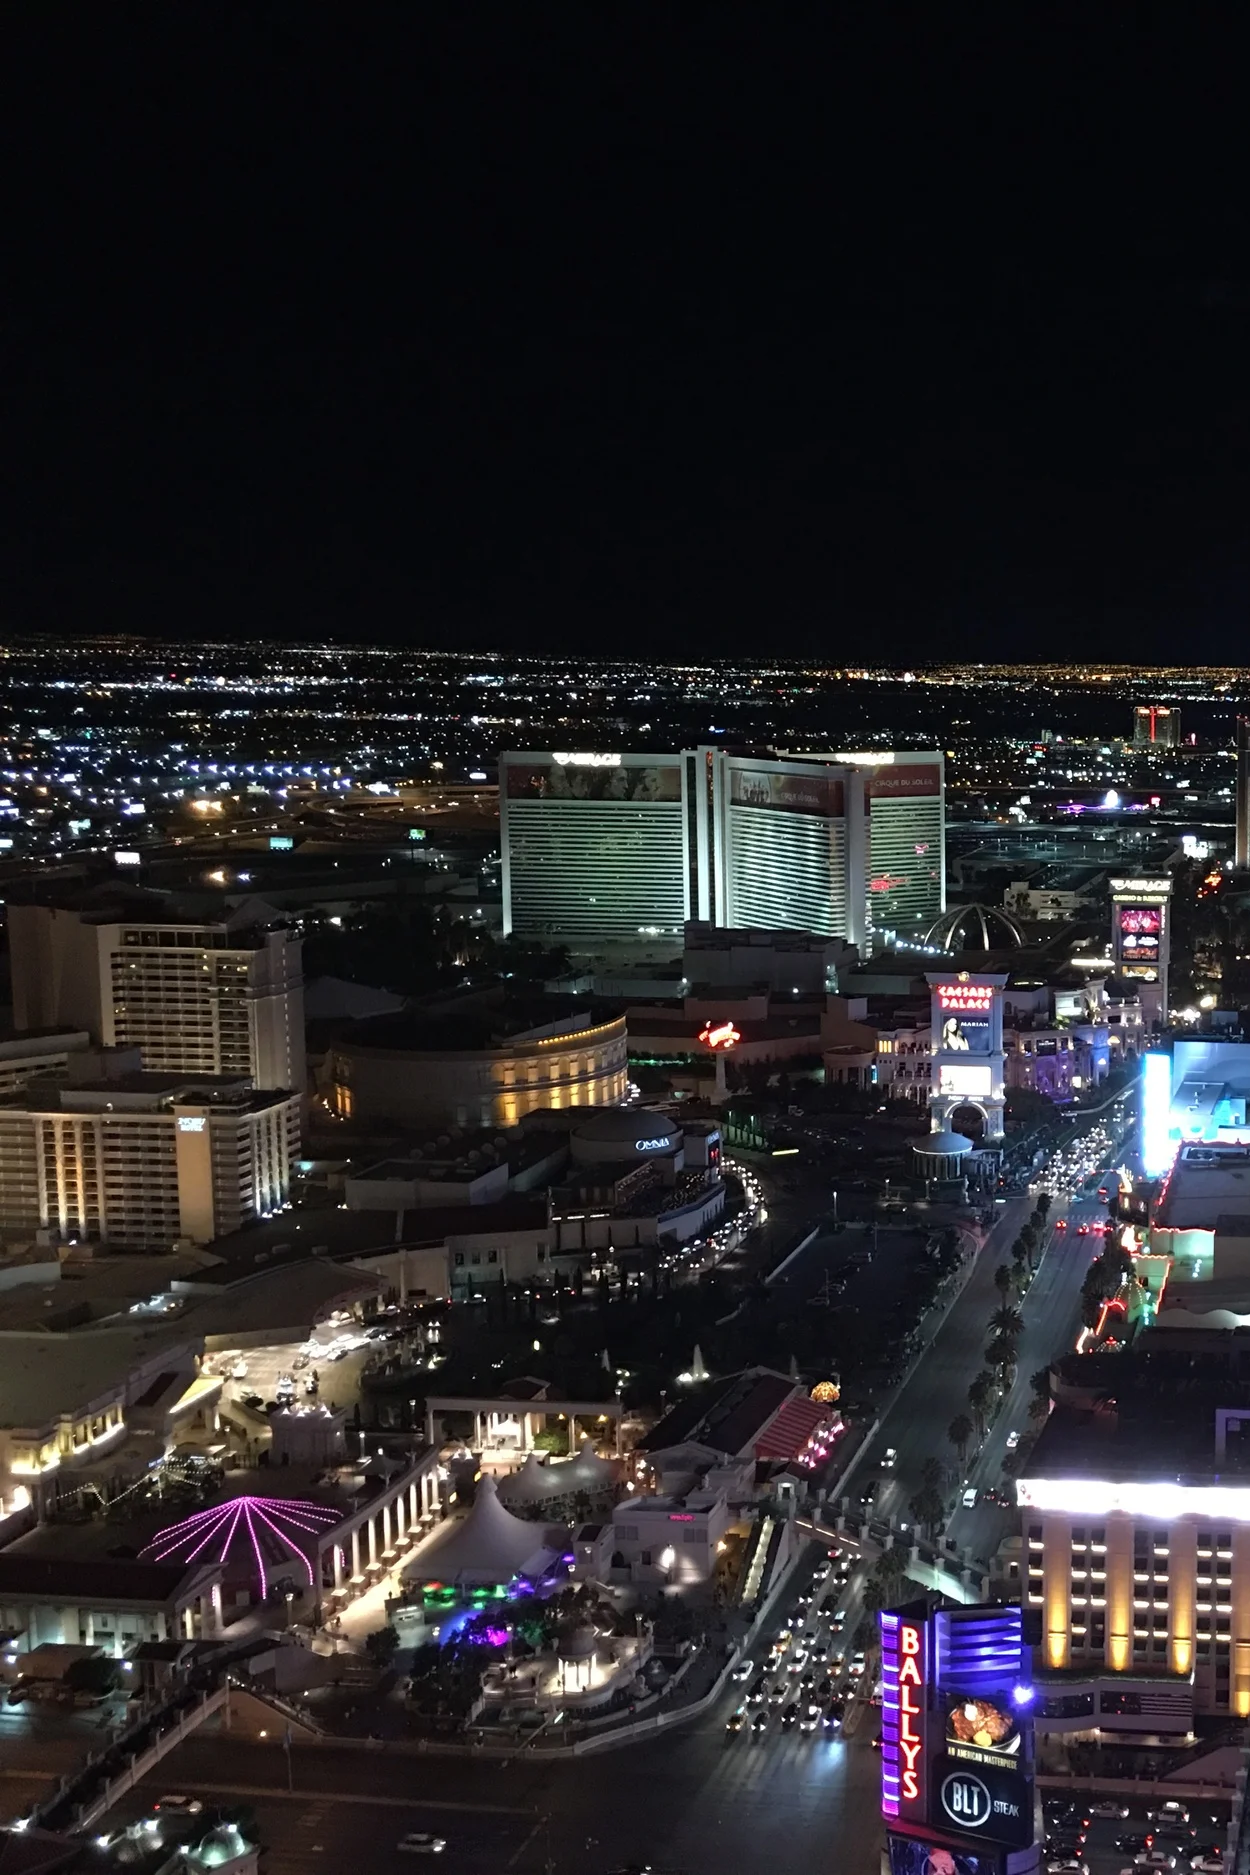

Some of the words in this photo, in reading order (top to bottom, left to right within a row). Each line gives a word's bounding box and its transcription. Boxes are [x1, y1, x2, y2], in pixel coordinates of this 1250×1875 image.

[938, 985, 992, 998] CAESARS
[941, 998, 990, 1009] PALACE
[957, 1748, 982, 1762] AMERICAN
[953, 1781, 980, 1816] BLT
[993, 1800, 1019, 1817] STEAK
